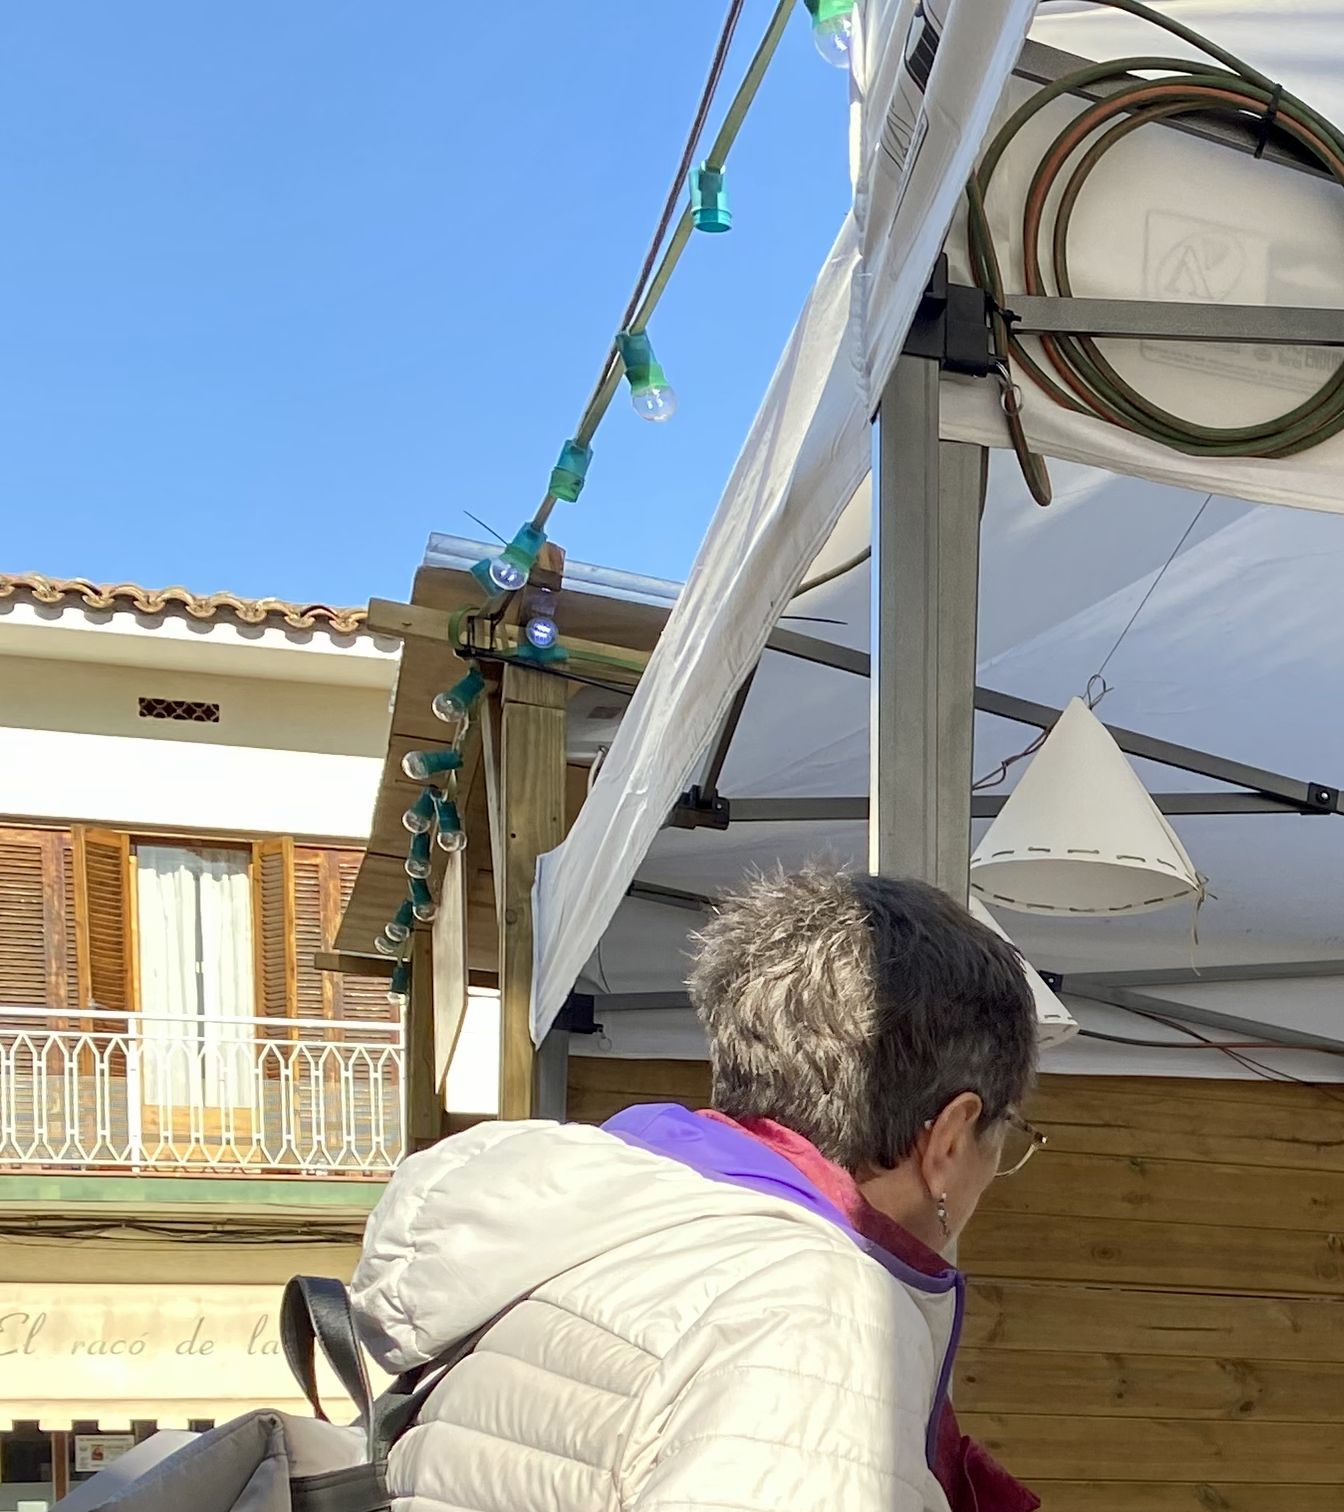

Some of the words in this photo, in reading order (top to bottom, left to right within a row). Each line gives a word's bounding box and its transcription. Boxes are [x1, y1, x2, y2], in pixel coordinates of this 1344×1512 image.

[0, 1312, 46, 1356] El
[71, 1331, 149, 1355] racó
[175, 1316, 215, 1355] de
